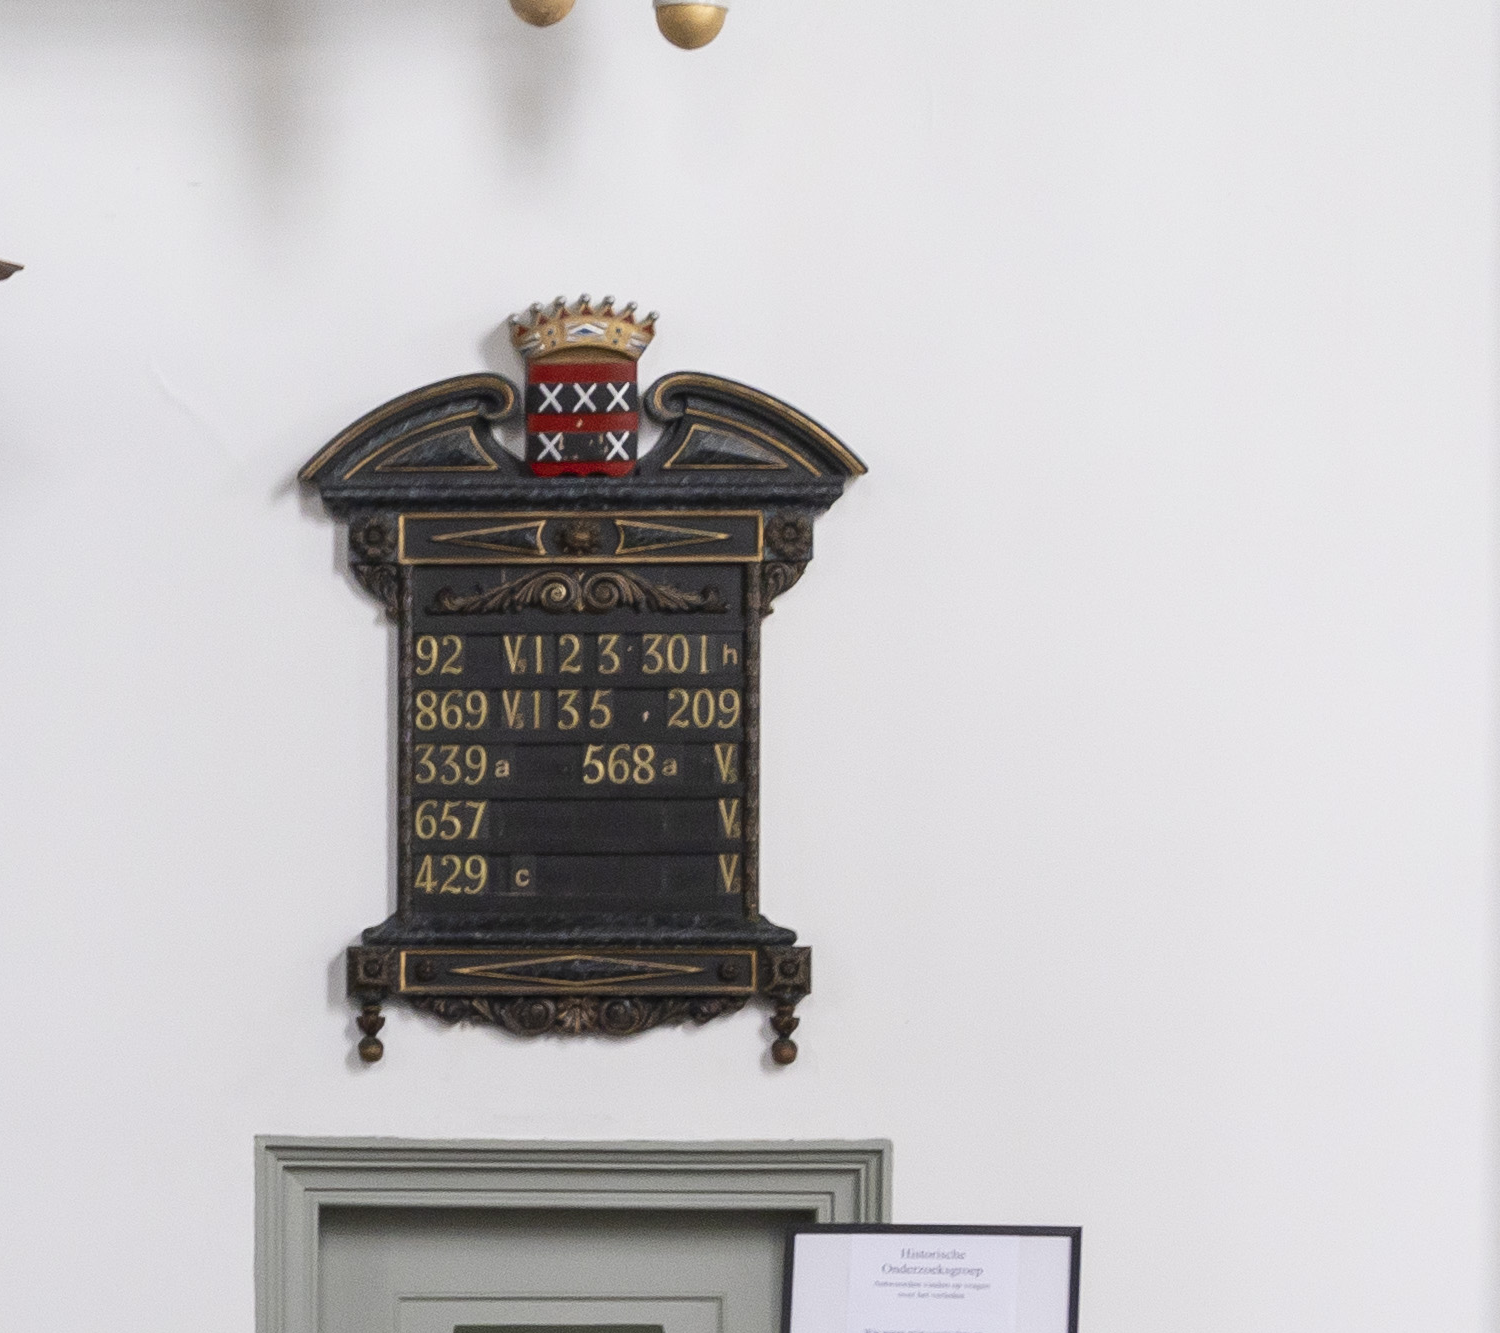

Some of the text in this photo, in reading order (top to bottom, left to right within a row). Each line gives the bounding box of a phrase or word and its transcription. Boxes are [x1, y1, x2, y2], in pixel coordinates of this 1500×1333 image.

[415, 634, 463, 676] 92
[414, 689, 489, 731] 869
[666, 687, 742, 730] 209
[414, 799, 489, 841] 657
[413, 854, 489, 895] 429
